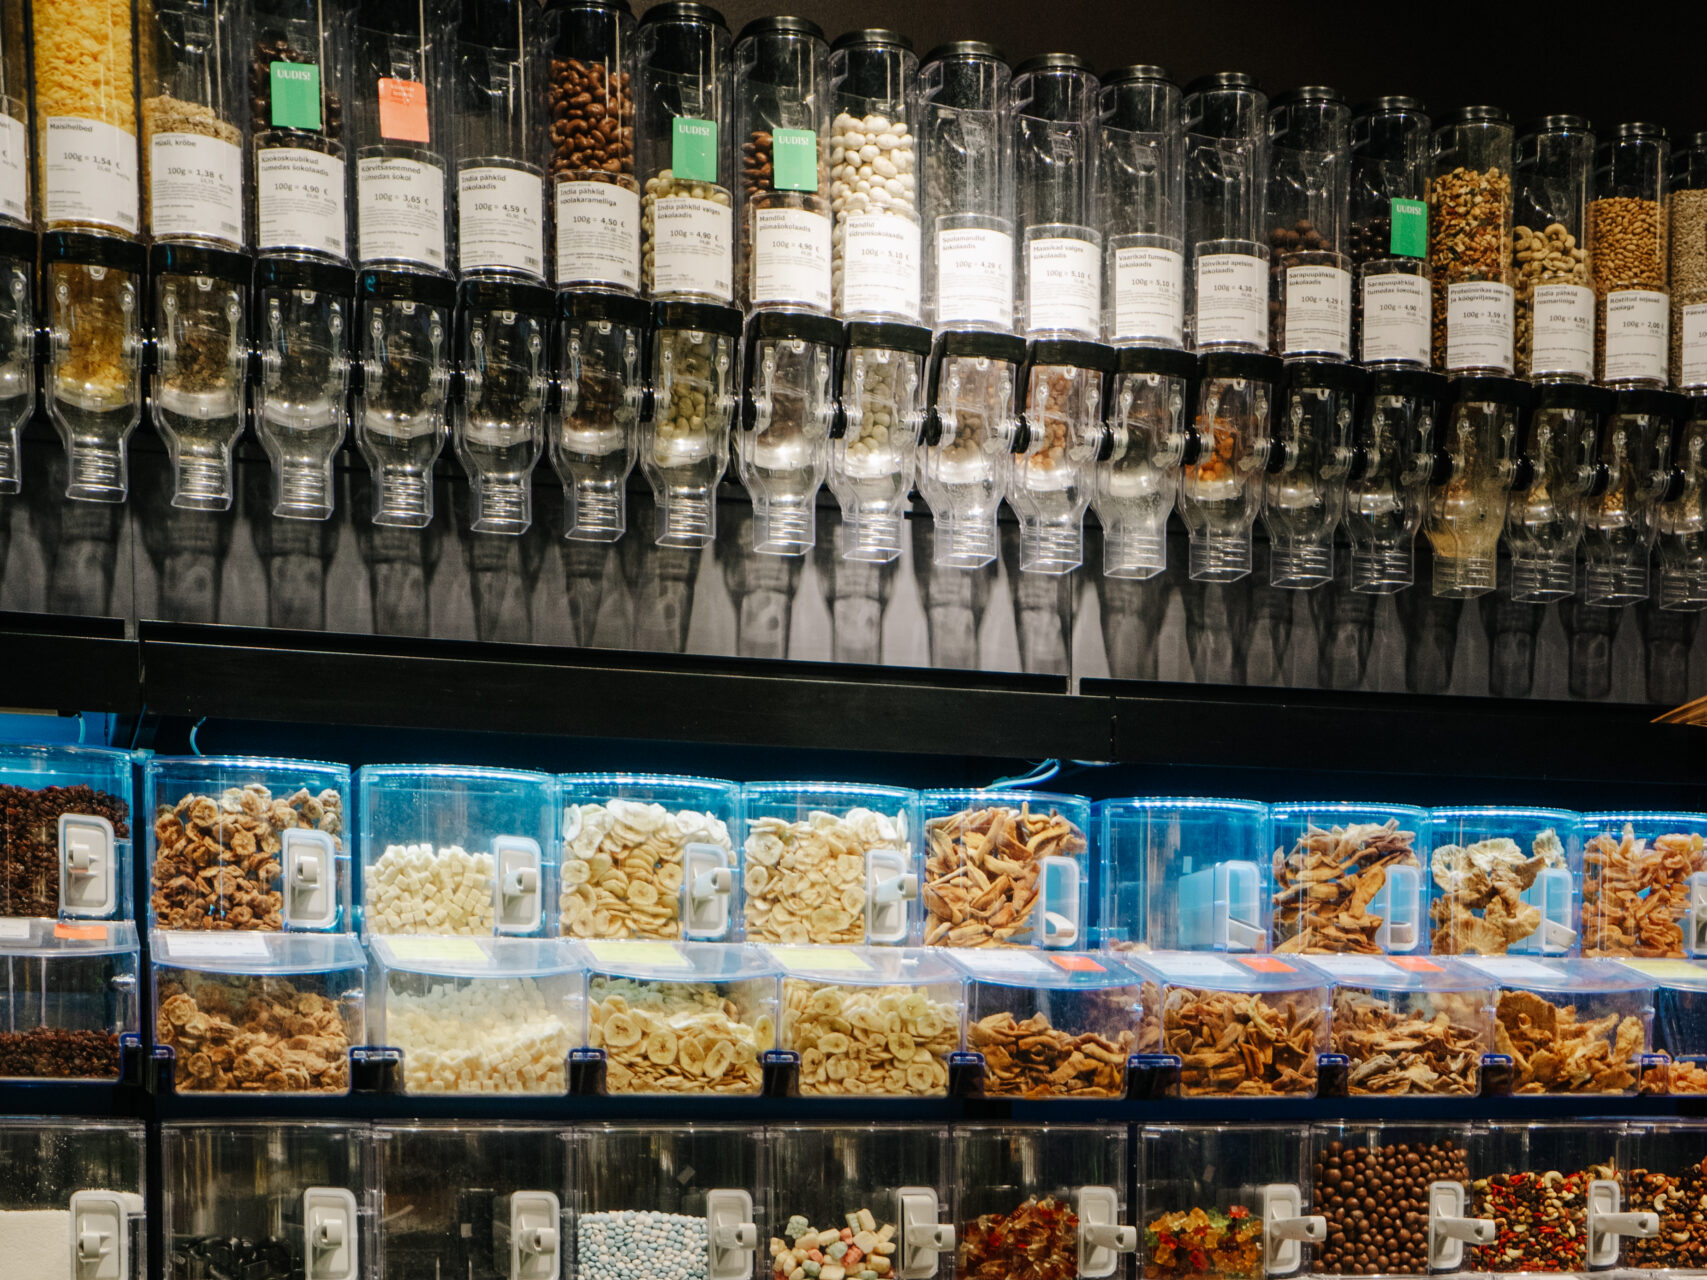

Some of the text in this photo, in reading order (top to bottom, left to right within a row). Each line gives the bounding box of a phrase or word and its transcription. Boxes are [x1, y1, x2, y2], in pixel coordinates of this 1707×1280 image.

[277, 68, 311, 81] UUDIS!
[49, 123, 93, 133] Maisihelbed
[678, 124, 710, 137] UUDIS!
[778, 135, 809, 146] UUDIS!
[63, 152, 82, 162] 100g
[93, 156, 111, 166] 1,54
[168, 168, 186, 176] 100g
[196, 169, 215, 178] 1,38
[361, 164, 422, 175] Kõrvitsaseemned
[274, 183, 293, 191] 100g
[302, 184, 320, 194] 4,90
[560, 188, 577, 196] India
[374, 192, 393, 202] 100g
[403, 193, 421, 205] 3,65
[474, 203, 492, 211] 100g
[502, 204, 520, 213] 4,59
[1396, 204, 1422, 215] UUDIS!
[573, 216, 591, 224] 100g
[670, 230, 687, 239] 100g
[772, 240, 789, 249] 100g
[861, 249, 879, 257] 100g
[956, 261, 972, 269] 100g
[1047, 270, 1063, 278] 100g
[1131, 279, 1148, 287] 100g
[1213, 284, 1230, 292] 100g
[1301, 296, 1318, 304] 100g
[1380, 303, 1396, 311] 100g
[1463, 311, 1479, 319] 100g
[1550, 315, 1566, 323] 100g
[1623, 321, 1640, 329] 100g
